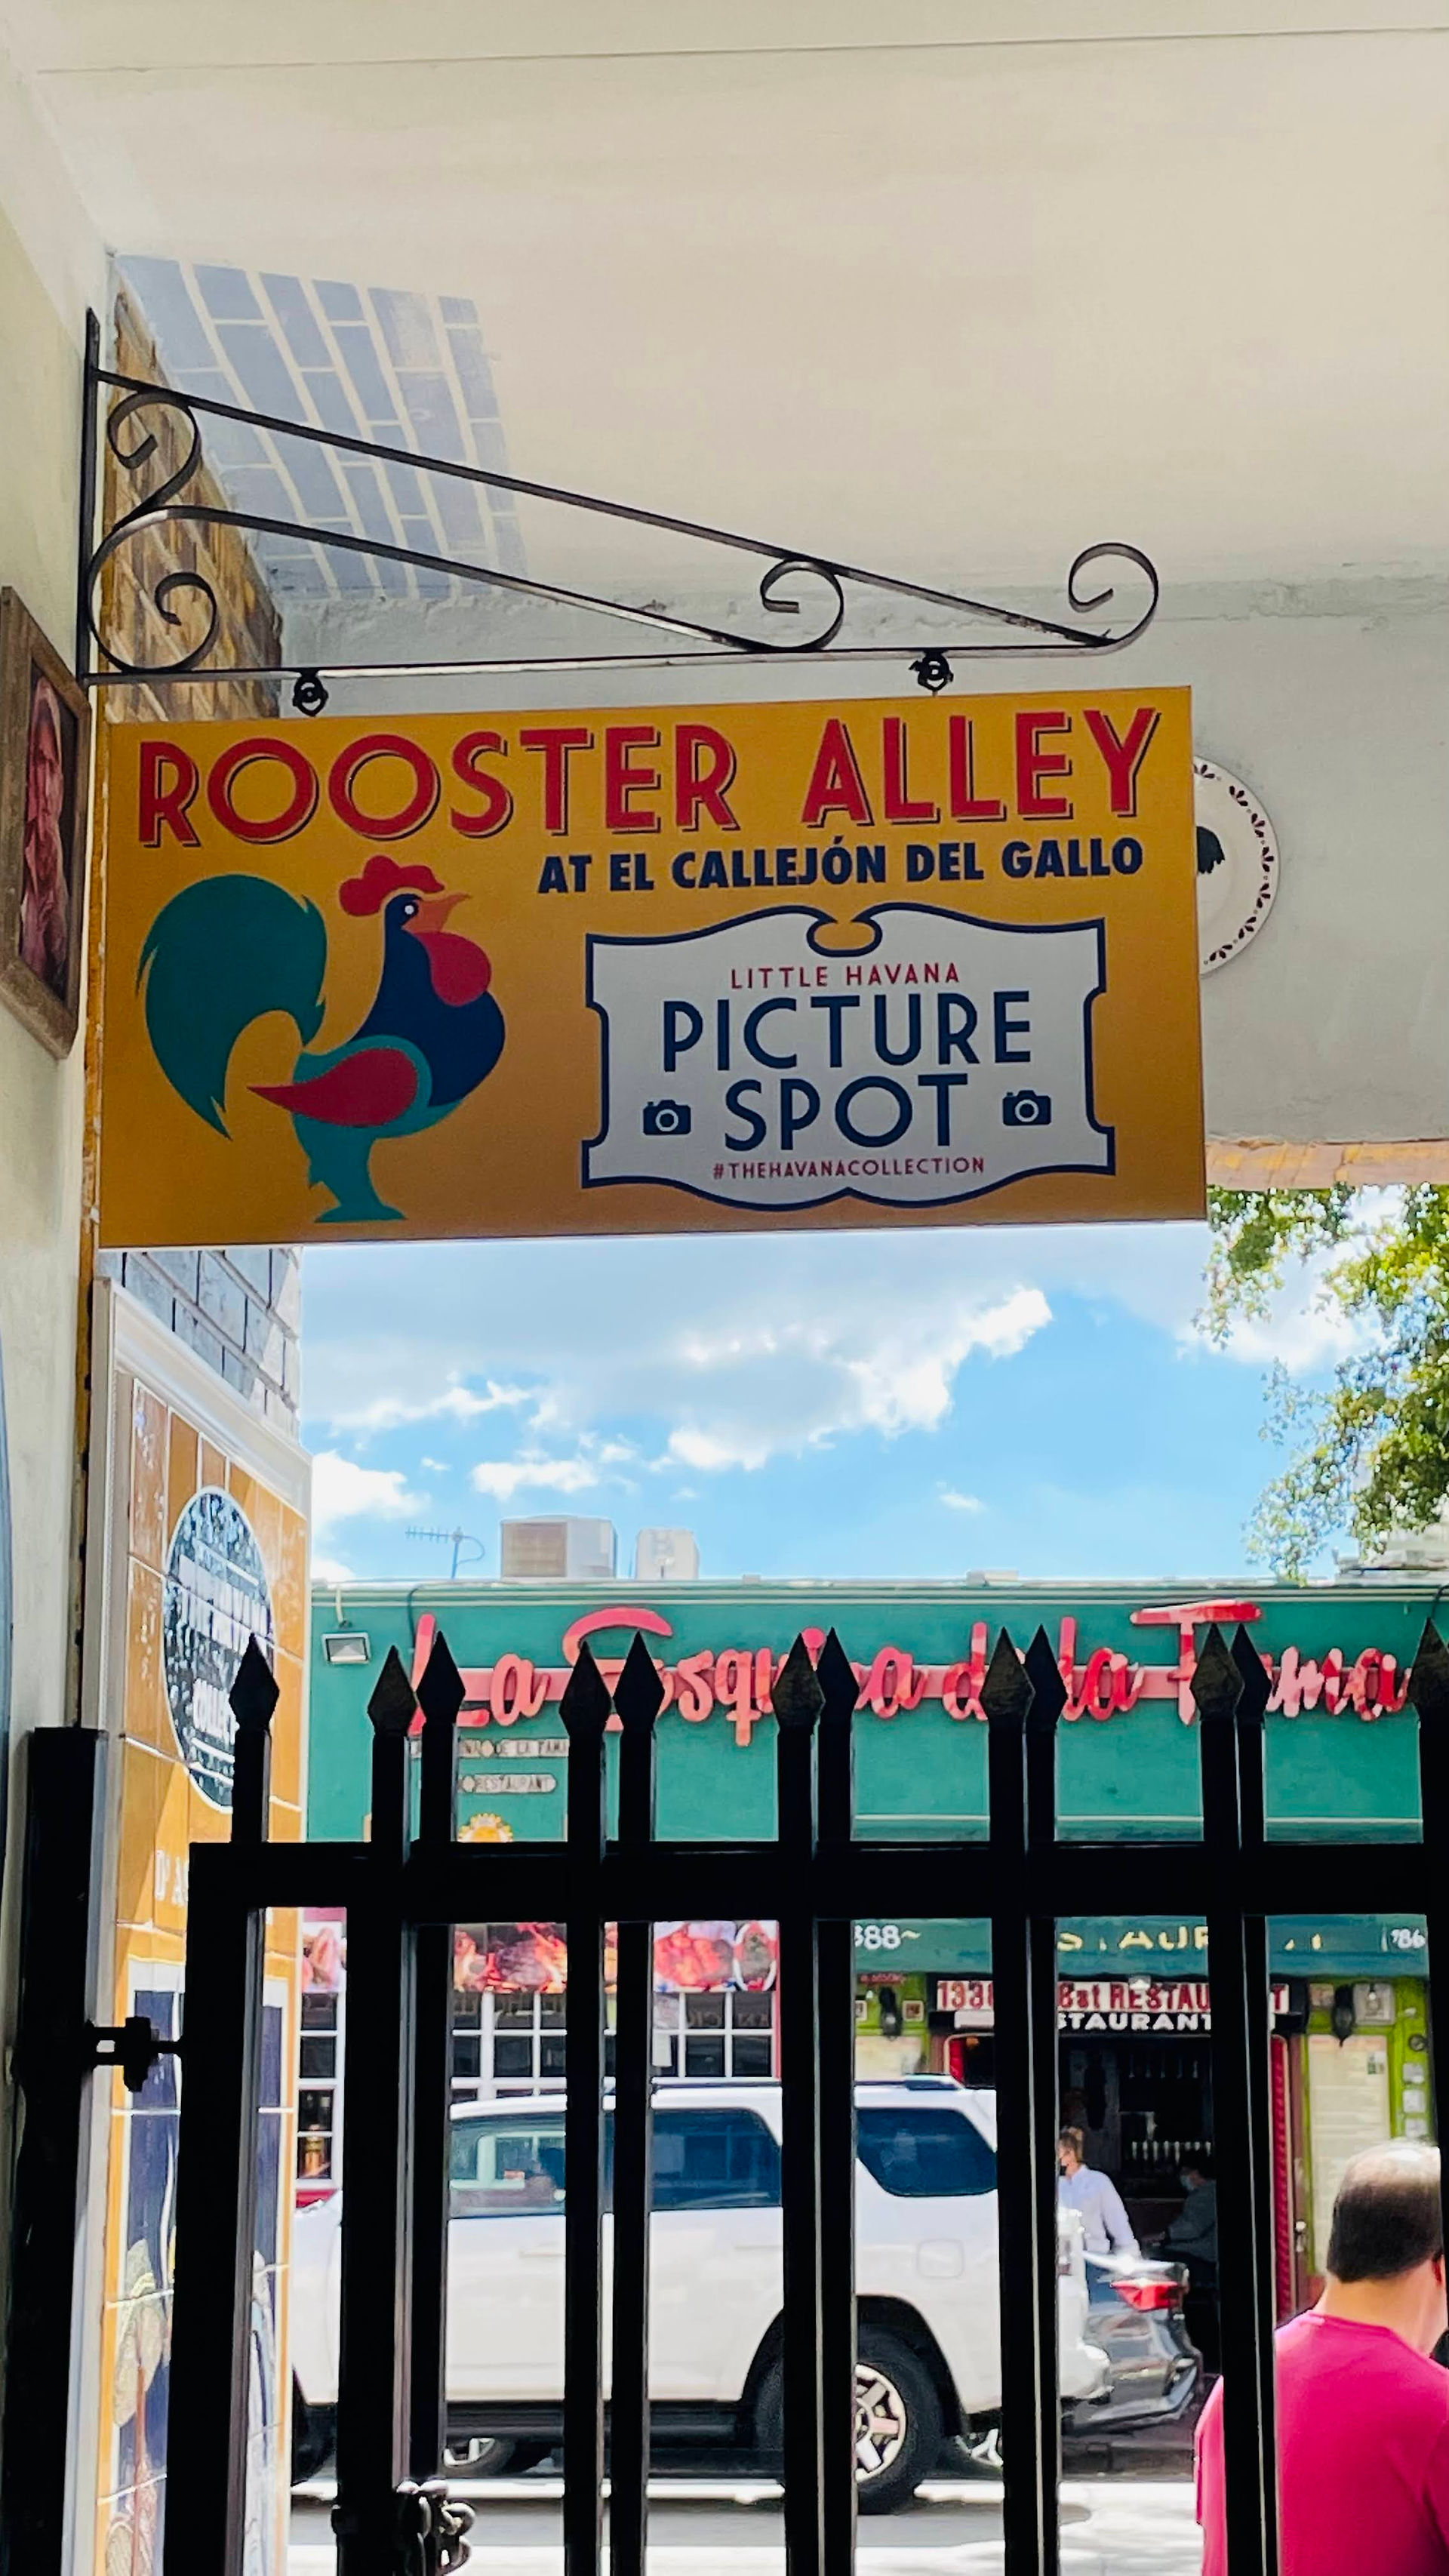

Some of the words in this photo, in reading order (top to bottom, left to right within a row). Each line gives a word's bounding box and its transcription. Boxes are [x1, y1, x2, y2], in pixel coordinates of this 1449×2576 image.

[138, 725, 740, 848] ROOSTER
[801, 707, 1161, 826] ALLEY
[538, 855, 592, 894] AT
[610, 854, 654, 891] EL
[672, 836, 885, 888] CALLEJÓN
[907, 843, 984, 882] DEL
[1002, 838, 1143, 878] GALLO
[731, 966, 828, 989] LITTLE
[845, 962, 961, 986] HAVANA
[663, 991, 1032, 1072] PICTURE
[724, 1073, 968, 1152] SPOT
[713, 1157, 985, 1180] #THEHAVANACOLLECTION
[1058, 1616, 1144, 1722] la
